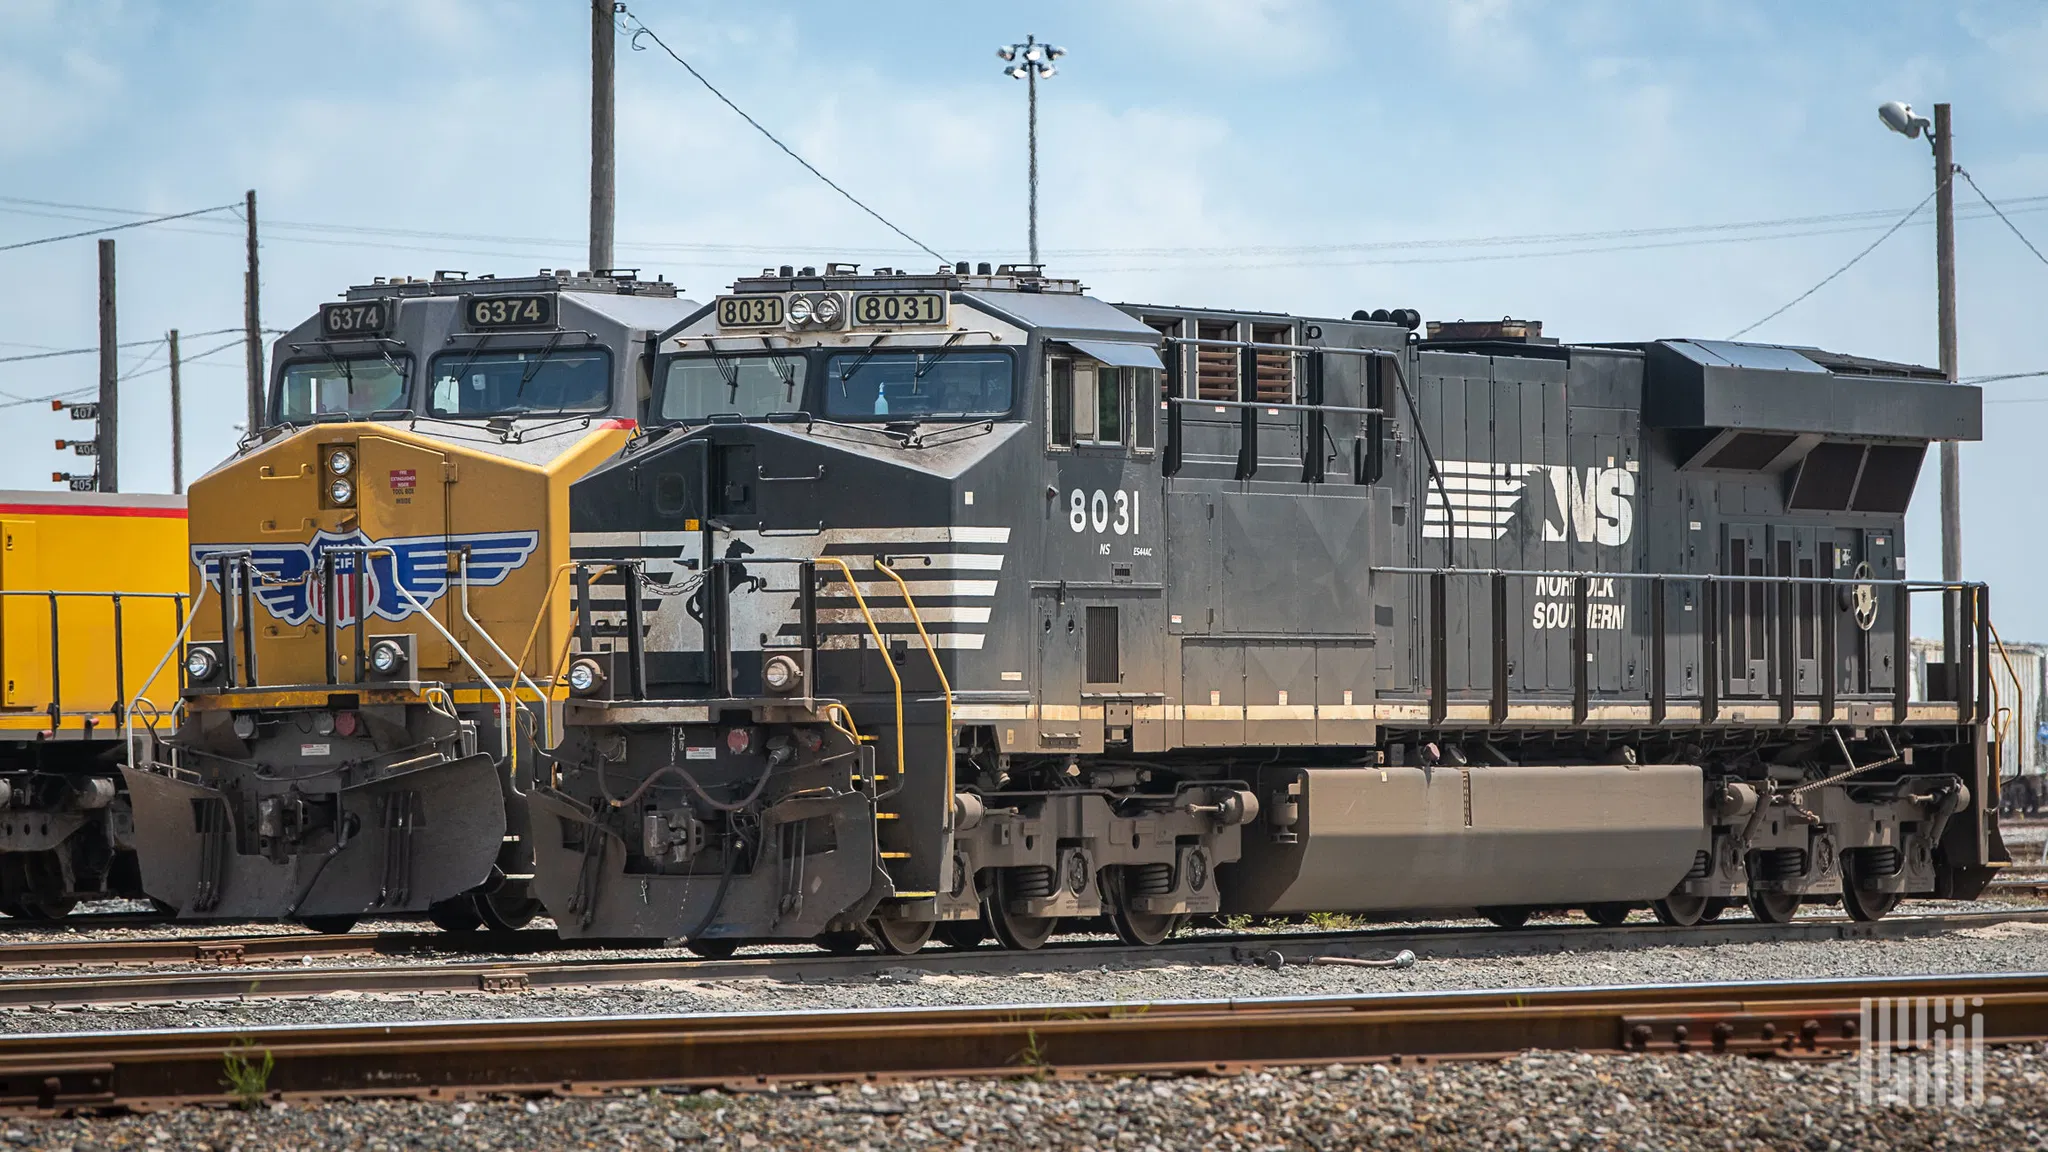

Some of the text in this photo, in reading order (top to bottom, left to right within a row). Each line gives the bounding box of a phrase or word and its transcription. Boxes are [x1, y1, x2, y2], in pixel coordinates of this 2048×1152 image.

[329, 306, 378, 330] 6374
[475, 299, 540, 323] 6374
[724, 301, 778, 323] 8031
[865, 297, 936, 320] 8031
[73, 408, 92, 418] 407
[71, 480, 92, 490] 405
[1069, 488, 1139, 535] 8031
[1099, 543, 1111, 555] NS
